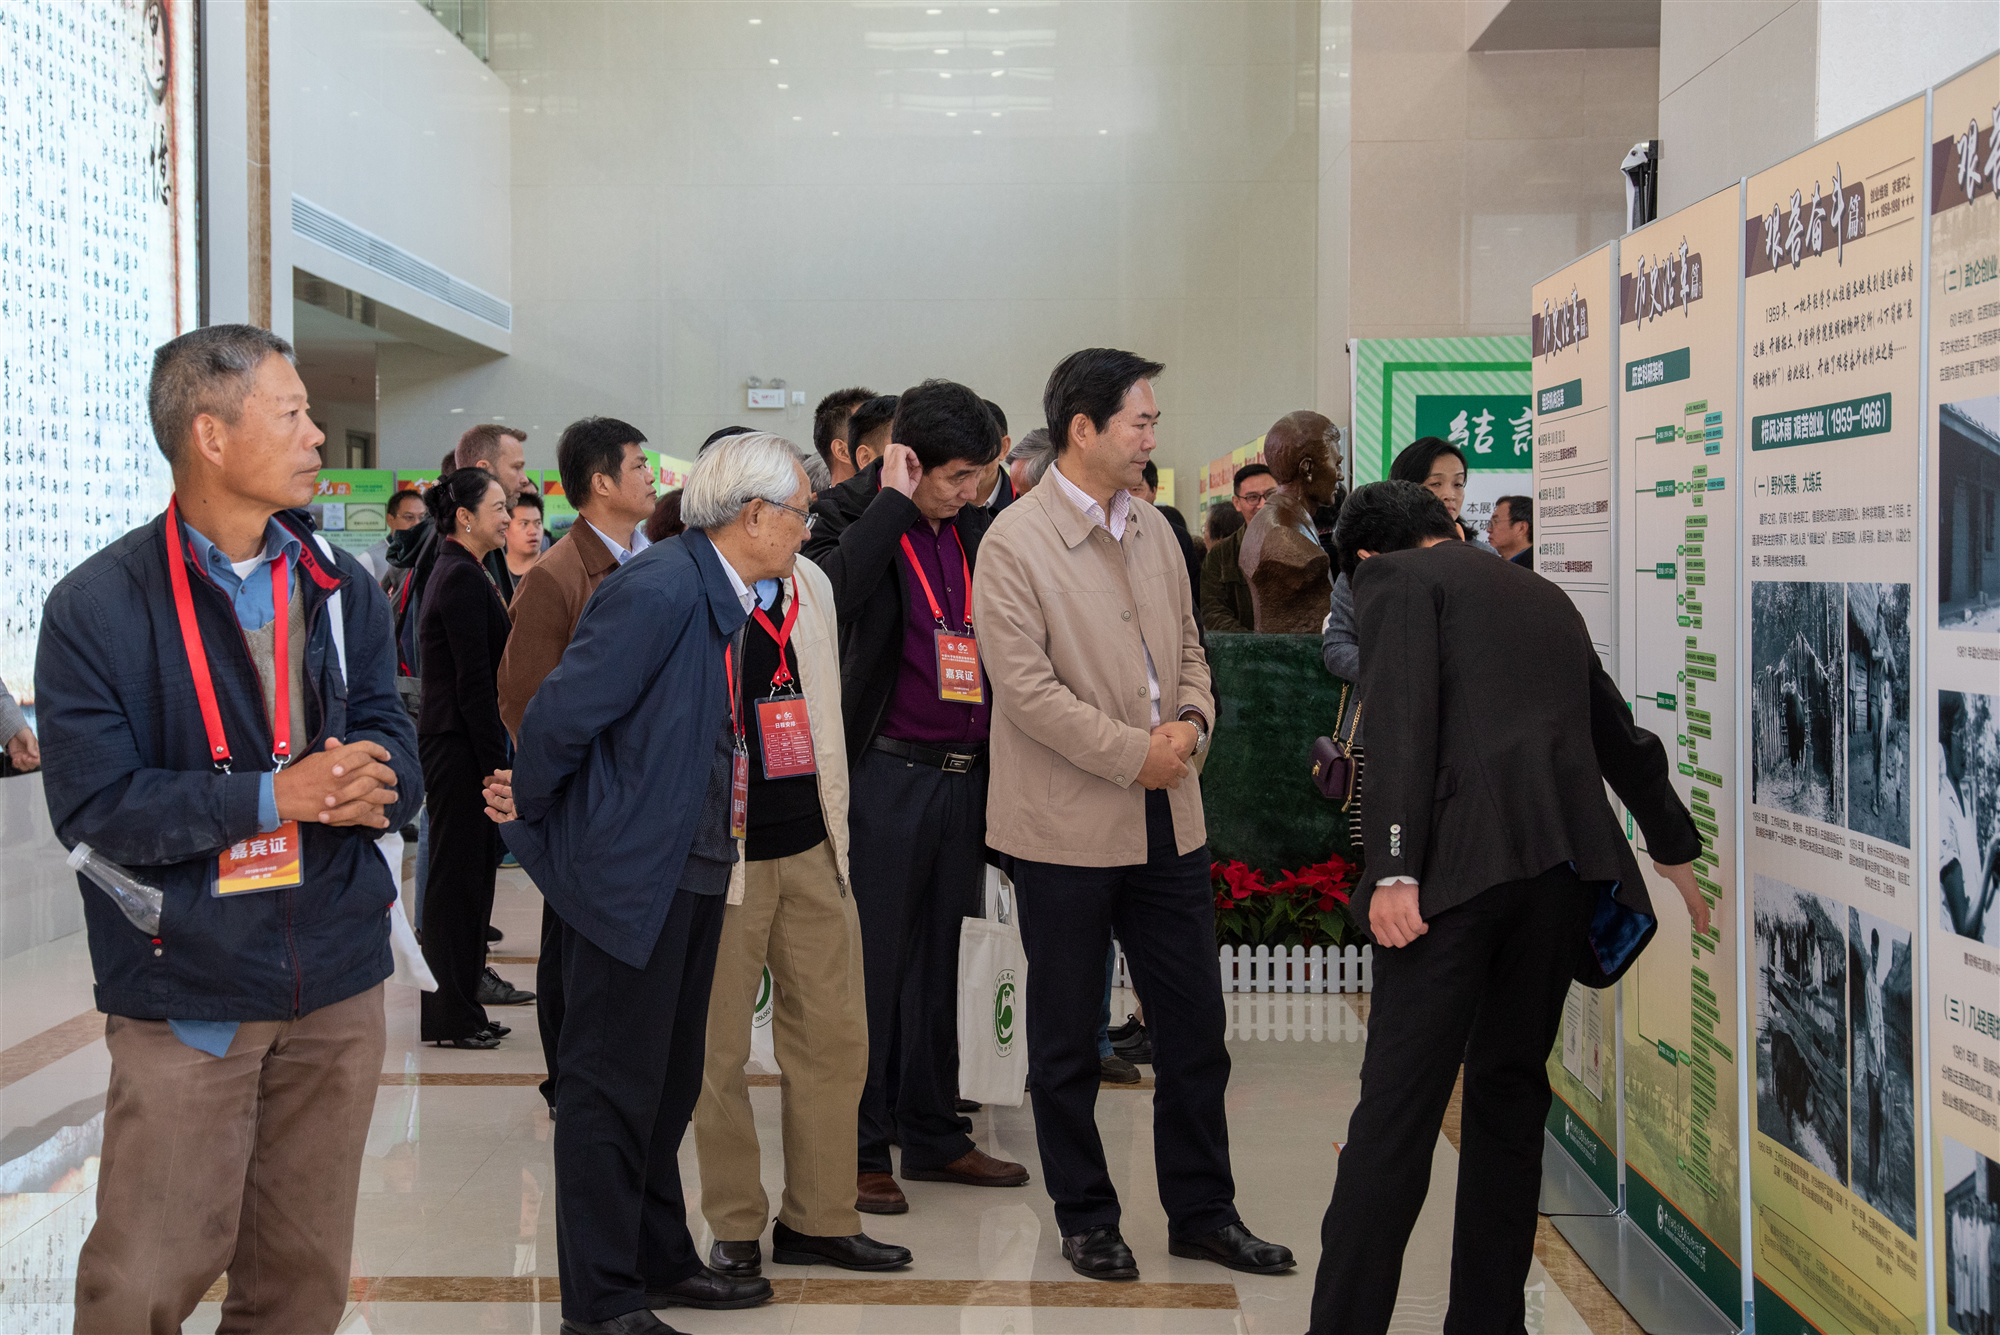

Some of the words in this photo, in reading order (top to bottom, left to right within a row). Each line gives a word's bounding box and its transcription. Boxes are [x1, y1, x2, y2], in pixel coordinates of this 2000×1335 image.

[1761, 416, 1792, 445] 栉风沐雨
[945, 668, 975, 682] 嘉宾证
[230, 836, 288, 861] 嘉宾证
